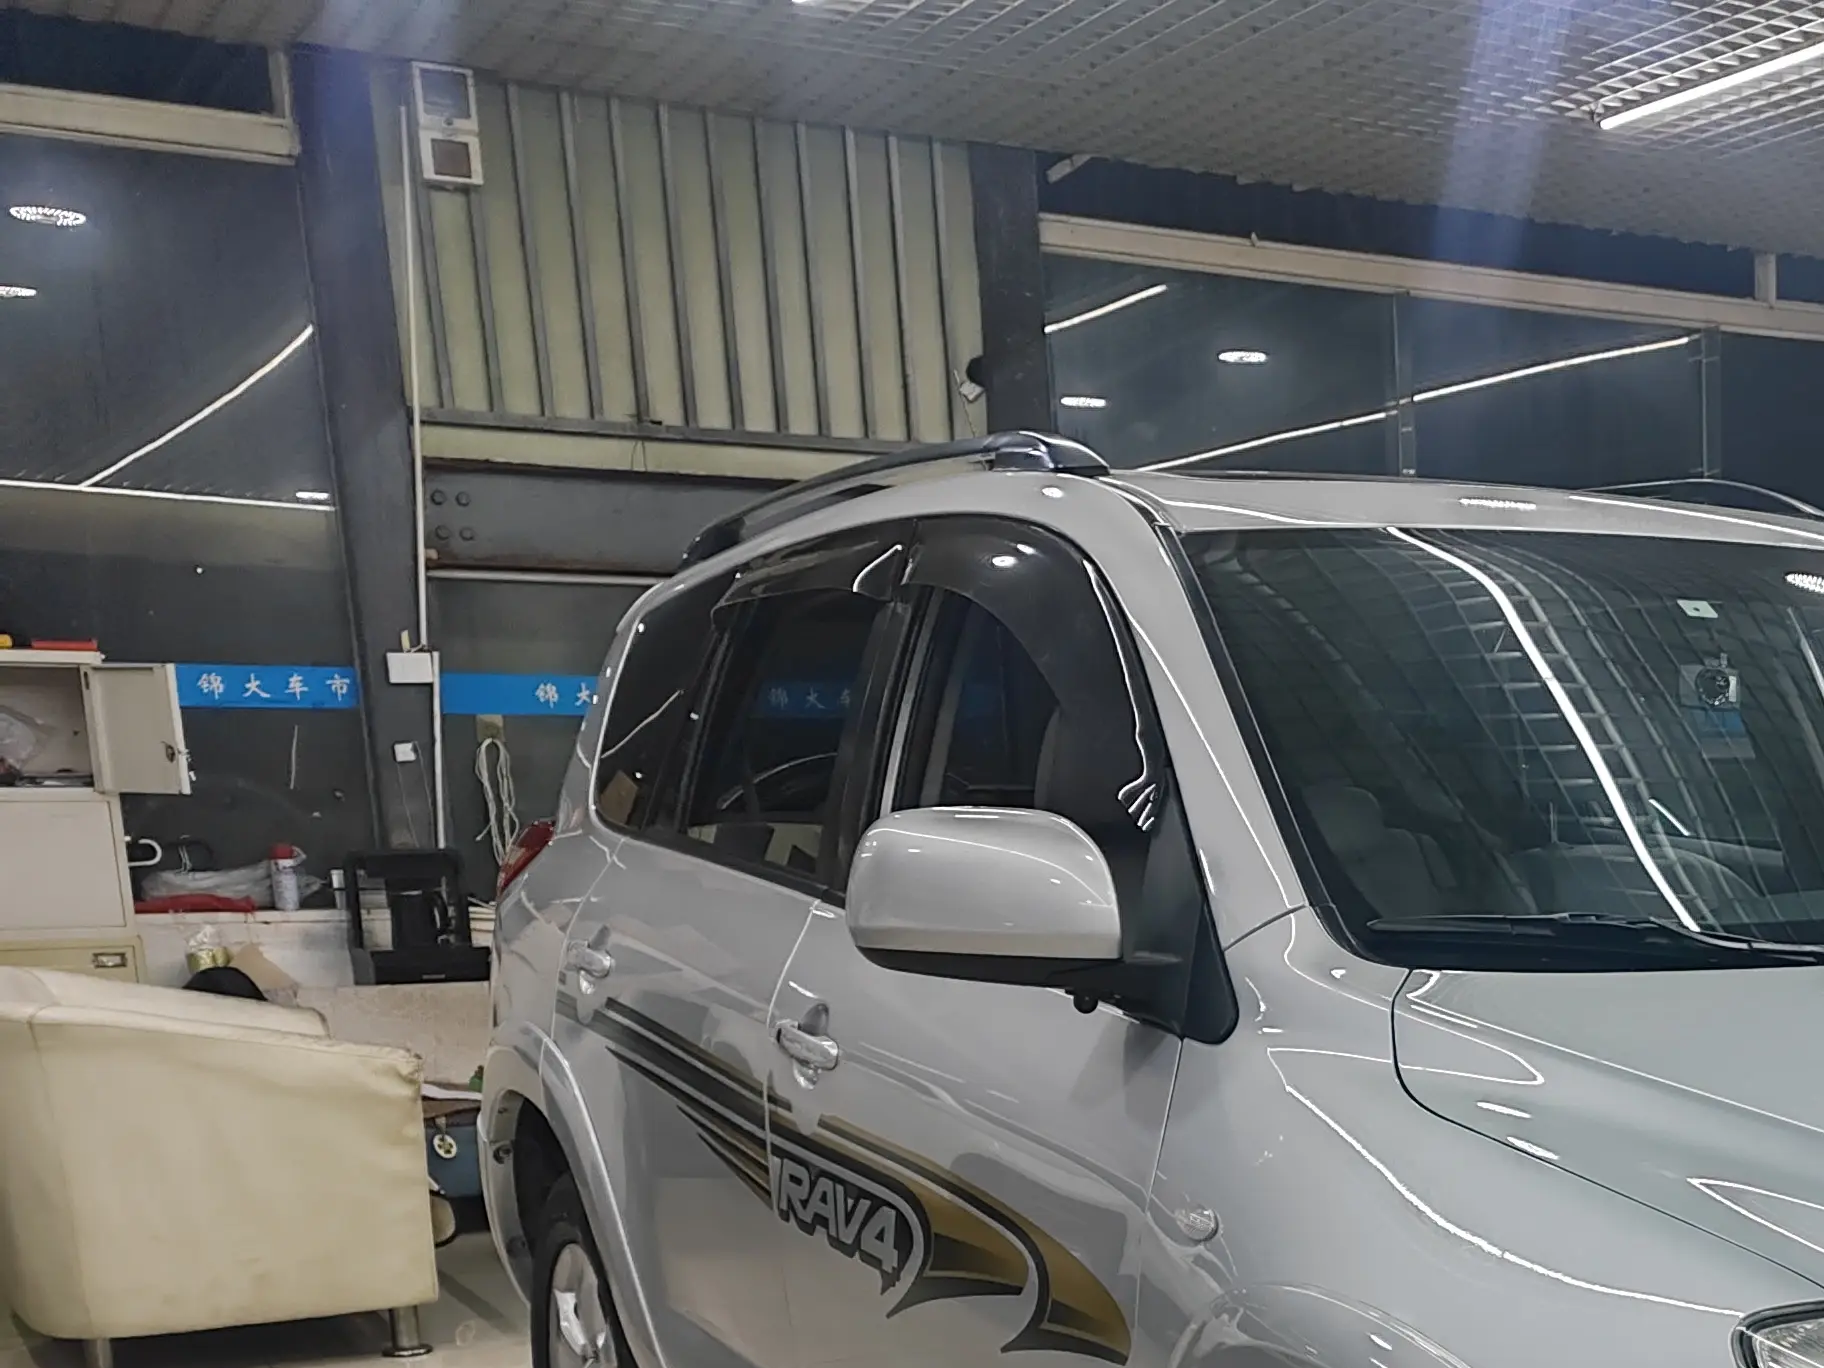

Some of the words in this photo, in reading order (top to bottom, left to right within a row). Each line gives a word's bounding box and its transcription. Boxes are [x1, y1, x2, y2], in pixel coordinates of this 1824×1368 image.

[197, 672, 350, 702] 锦大车市
[779, 1158, 899, 1274] RAV4
